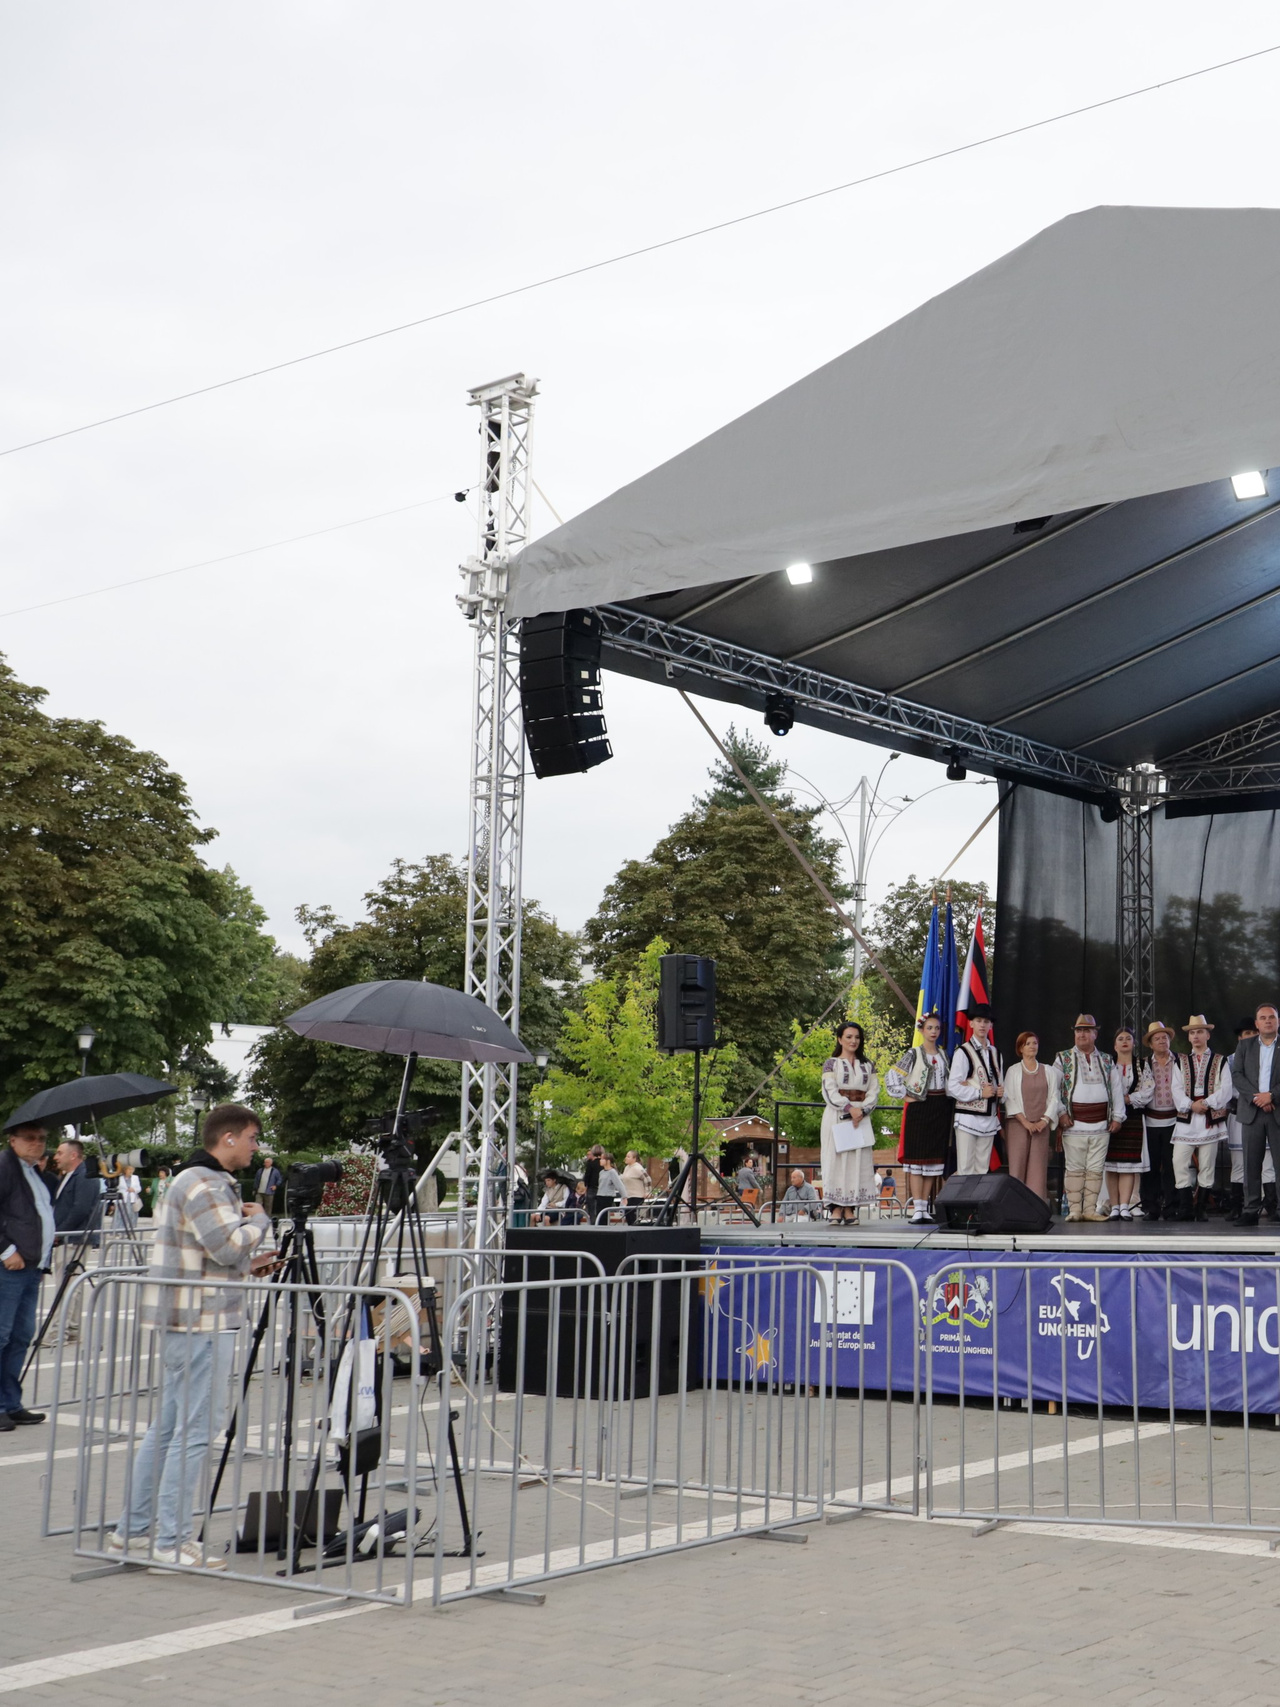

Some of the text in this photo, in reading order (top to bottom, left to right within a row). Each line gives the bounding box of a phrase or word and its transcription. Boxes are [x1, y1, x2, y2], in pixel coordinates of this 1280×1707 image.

[1038, 1322, 1098, 1338] UNGHENI
[940, 1332, 972, 1342] PRIMĂIA
[837, 1340, 876, 1351] Europnă
[963, 1346, 993, 1355] UNGHENI
